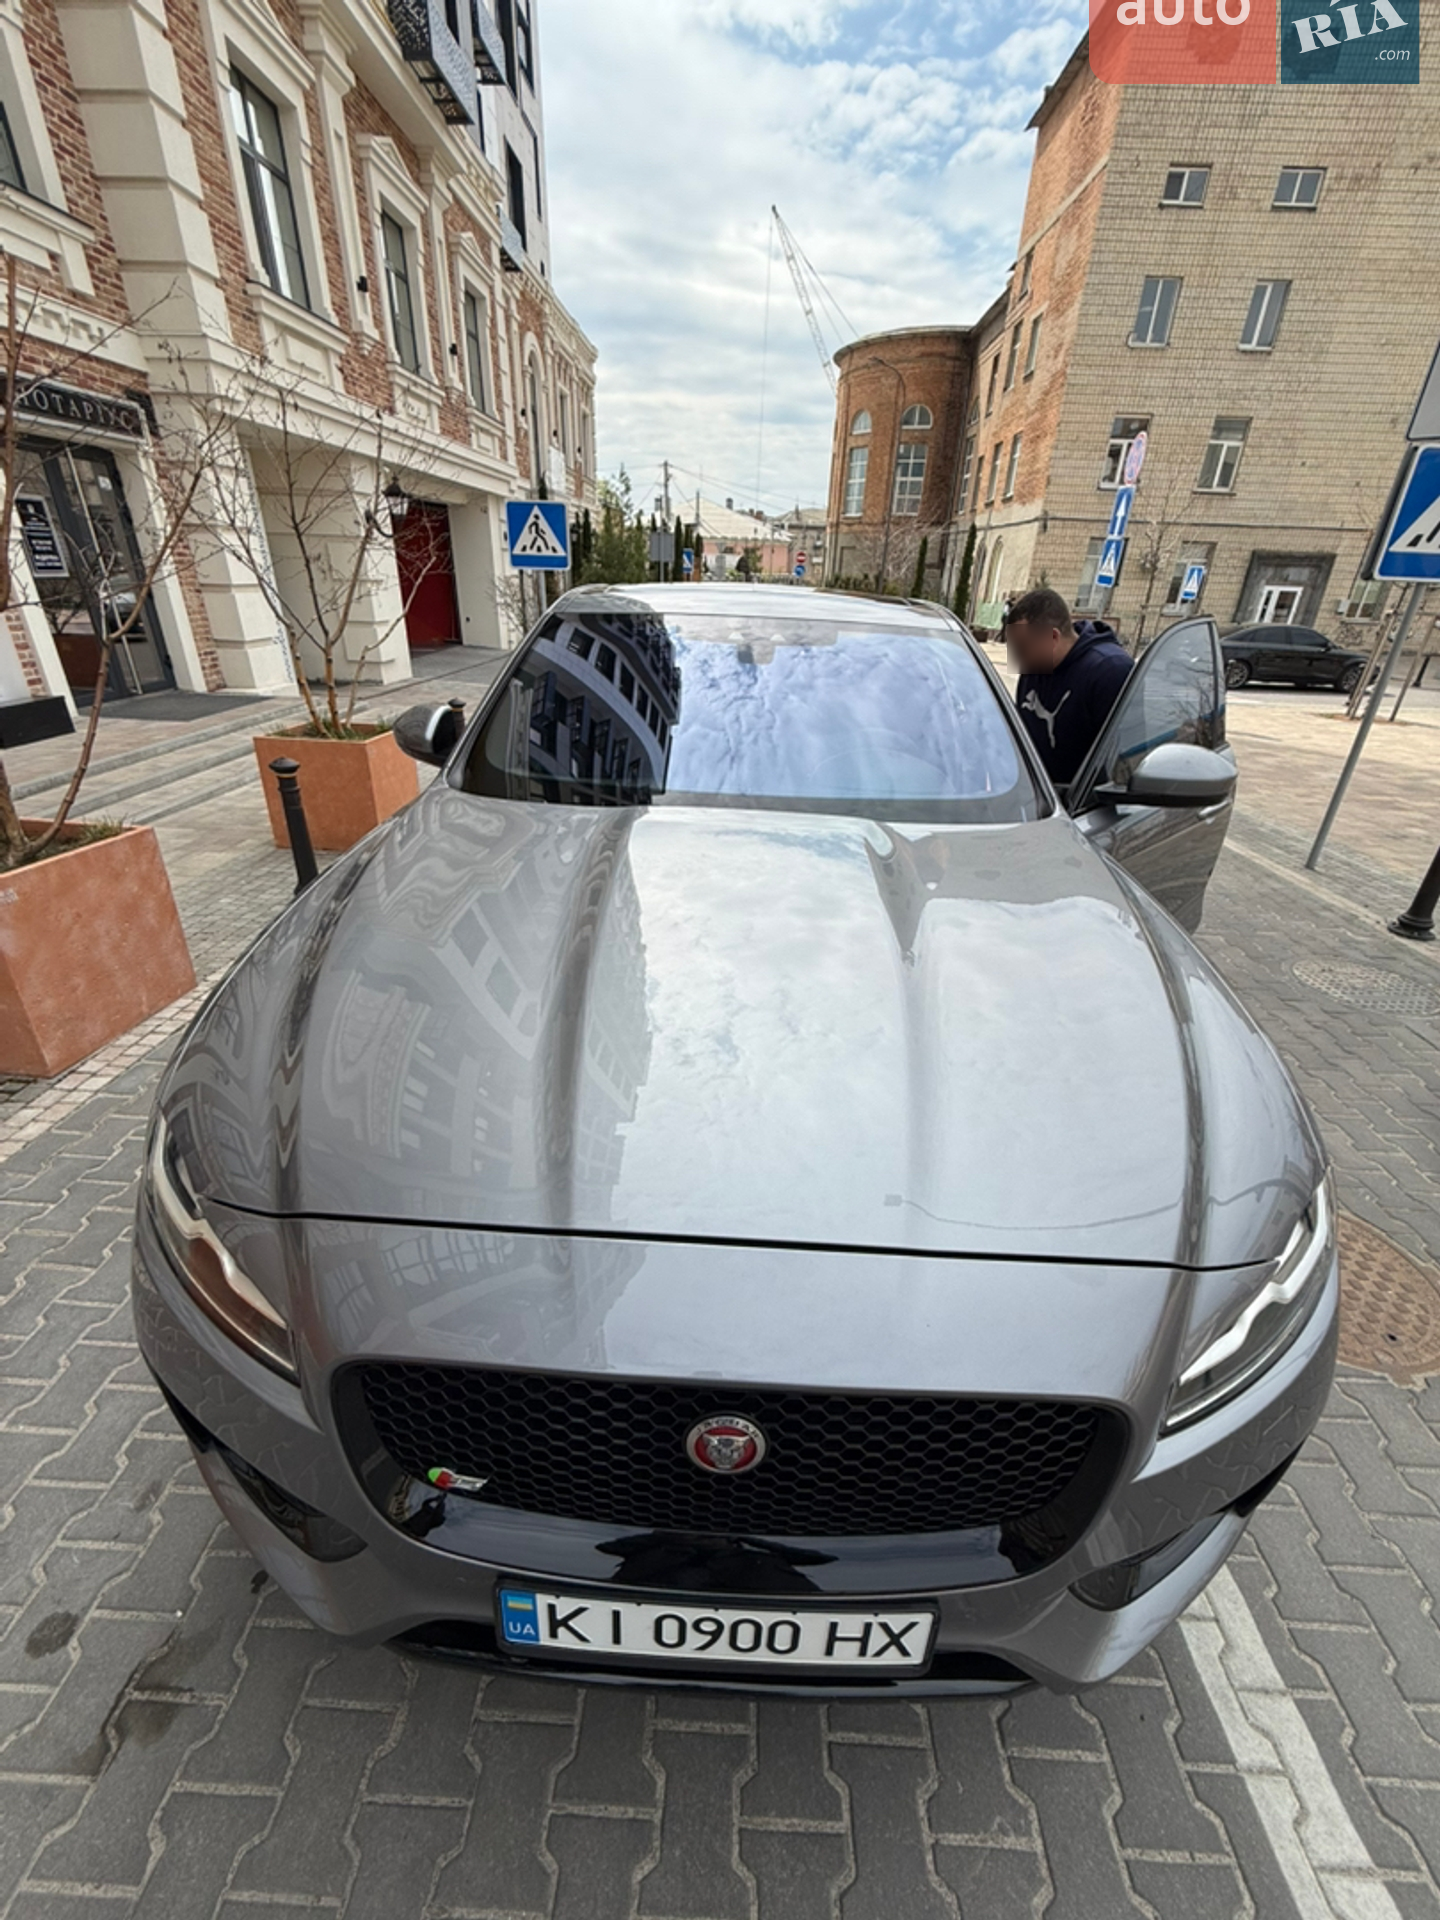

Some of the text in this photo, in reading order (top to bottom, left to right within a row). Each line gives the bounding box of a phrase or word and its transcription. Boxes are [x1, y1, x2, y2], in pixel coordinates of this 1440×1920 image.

[509, 1621, 536, 1636] UA
[653, 1613, 801, 1655] 0900
[824, 1620, 919, 1658] HX
